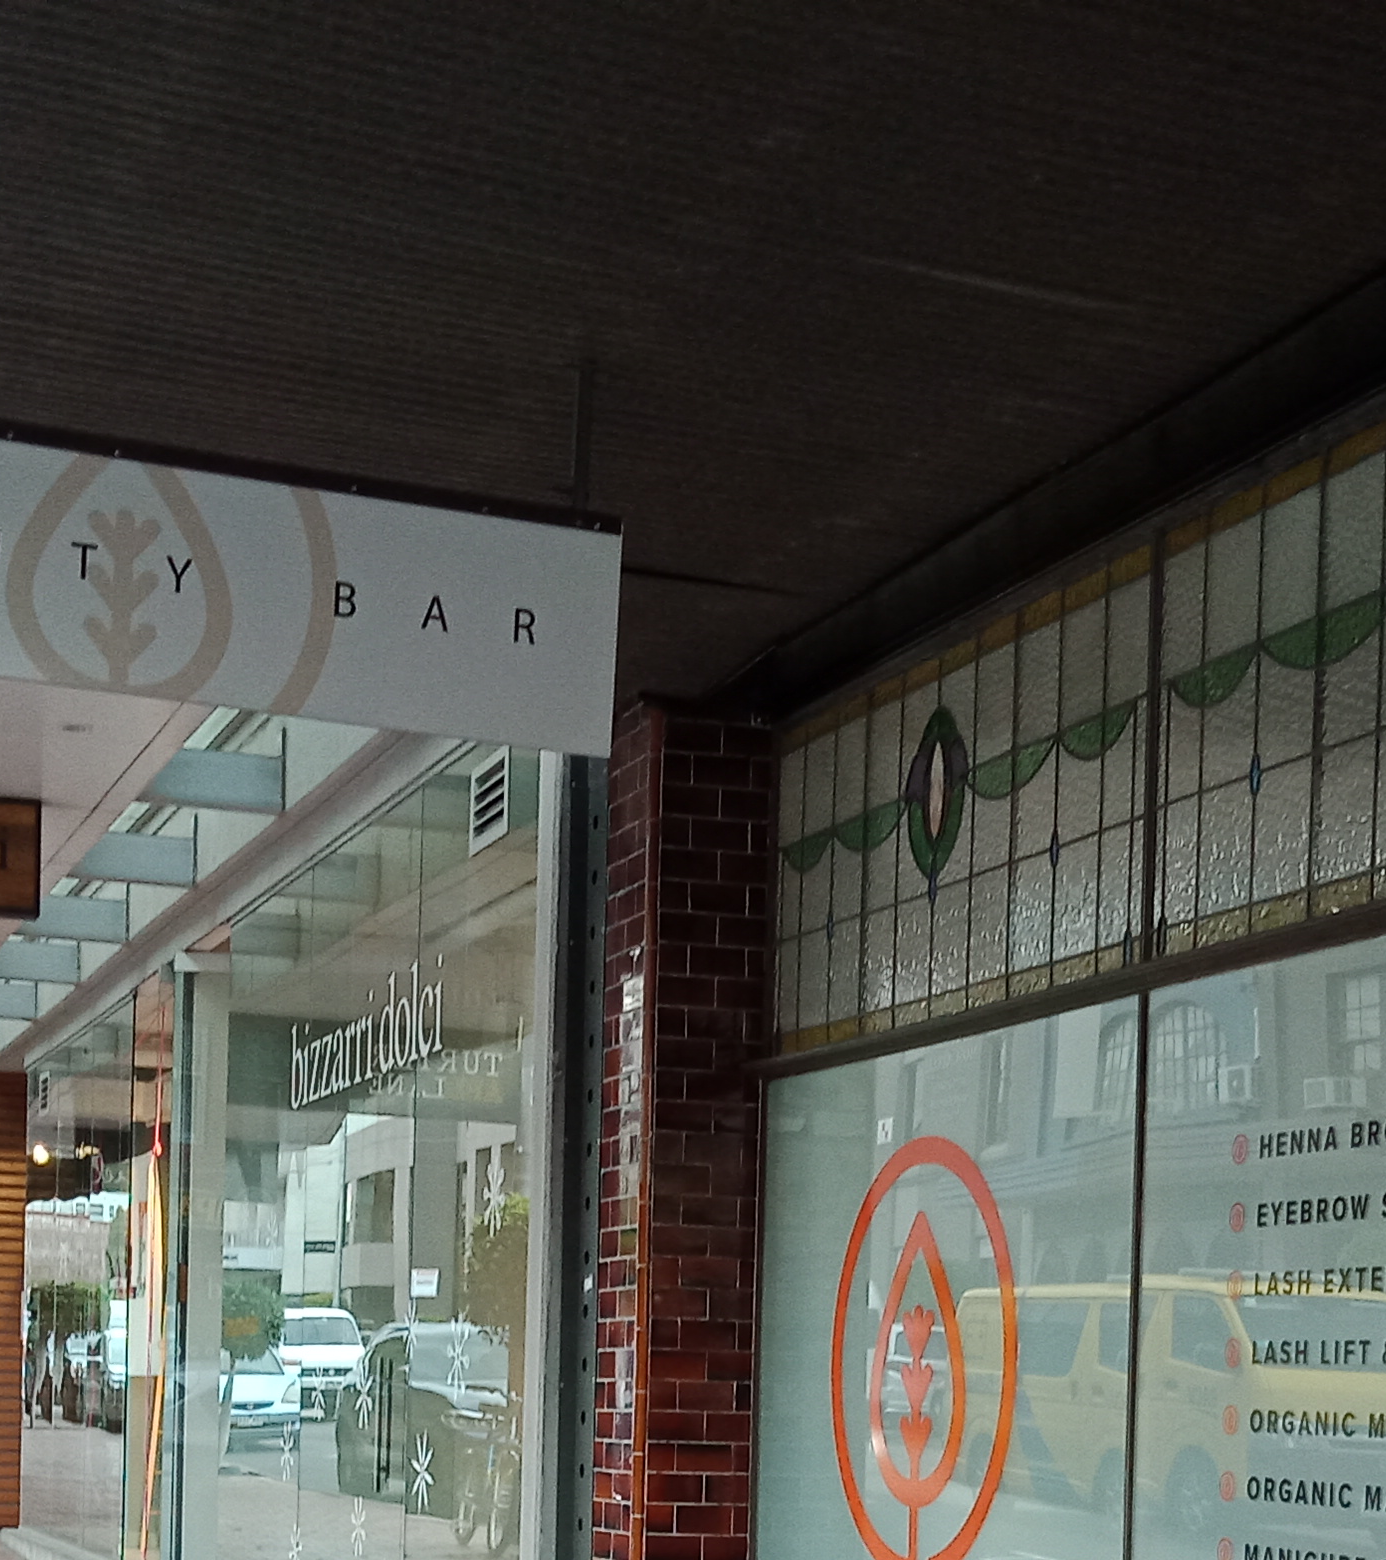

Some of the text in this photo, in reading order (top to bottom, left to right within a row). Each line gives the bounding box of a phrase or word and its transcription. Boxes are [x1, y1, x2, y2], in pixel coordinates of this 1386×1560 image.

[333, 580, 538, 646] BAR
[291, 953, 443, 1111] bizzarri dolci
[1258, 1126, 1337, 1160] HENNA
[1256, 1194, 1370, 1228] EYEBROW
[1253, 1270, 1312, 1297] LASH
[1251, 1341, 1309, 1365] LASH
[1320, 1340, 1371, 1364] LIFT
[1249, 1409, 1356, 1438] ORGANIC
[1246, 1475, 1353, 1509] ORGANIC
